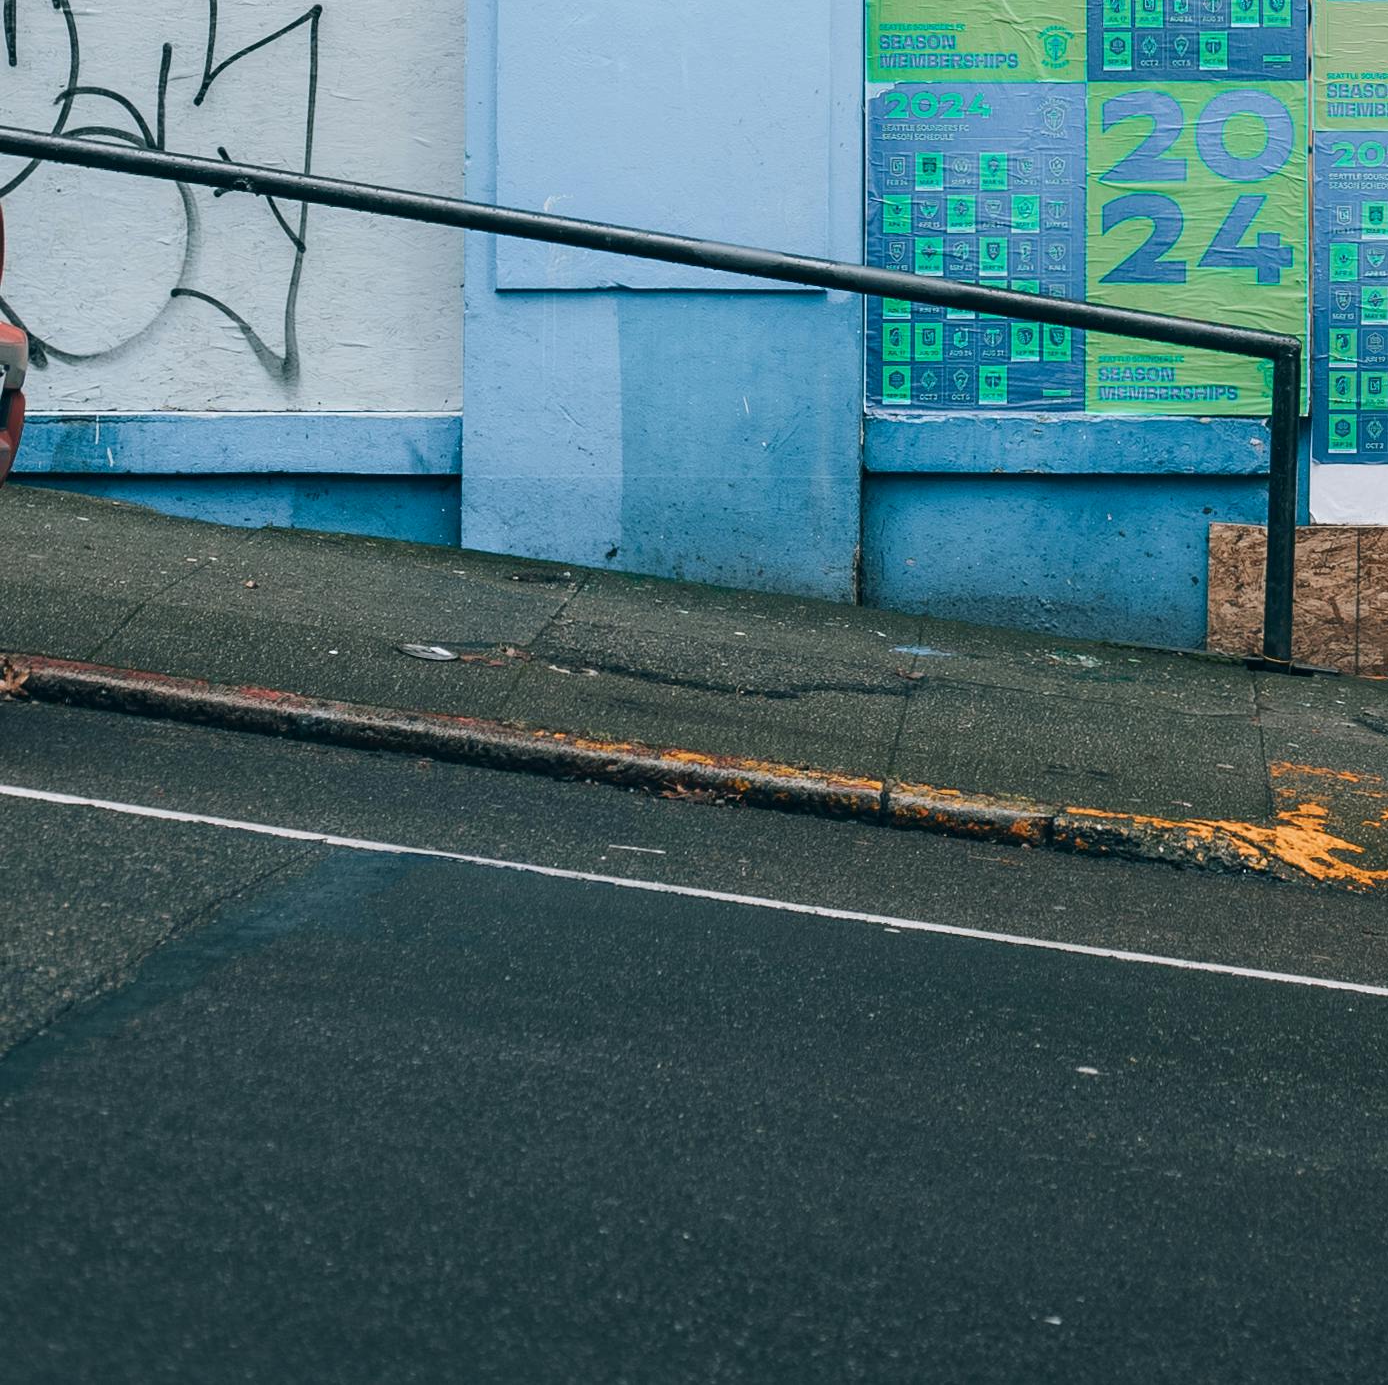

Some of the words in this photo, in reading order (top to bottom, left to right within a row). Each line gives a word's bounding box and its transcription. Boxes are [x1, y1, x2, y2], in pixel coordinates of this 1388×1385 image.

[879, 35, 956, 50] SEASON
[879, 53, 1019, 69] MEMBERSHIPS
[883, 92, 992, 119] 2024
[1099, 89, 1295, 183] 20
[1099, 191, 1295, 285] 24
[1098, 366, 1175, 382] SEASON
[1098, 385, 1239, 401] MEMBERSHIPS
